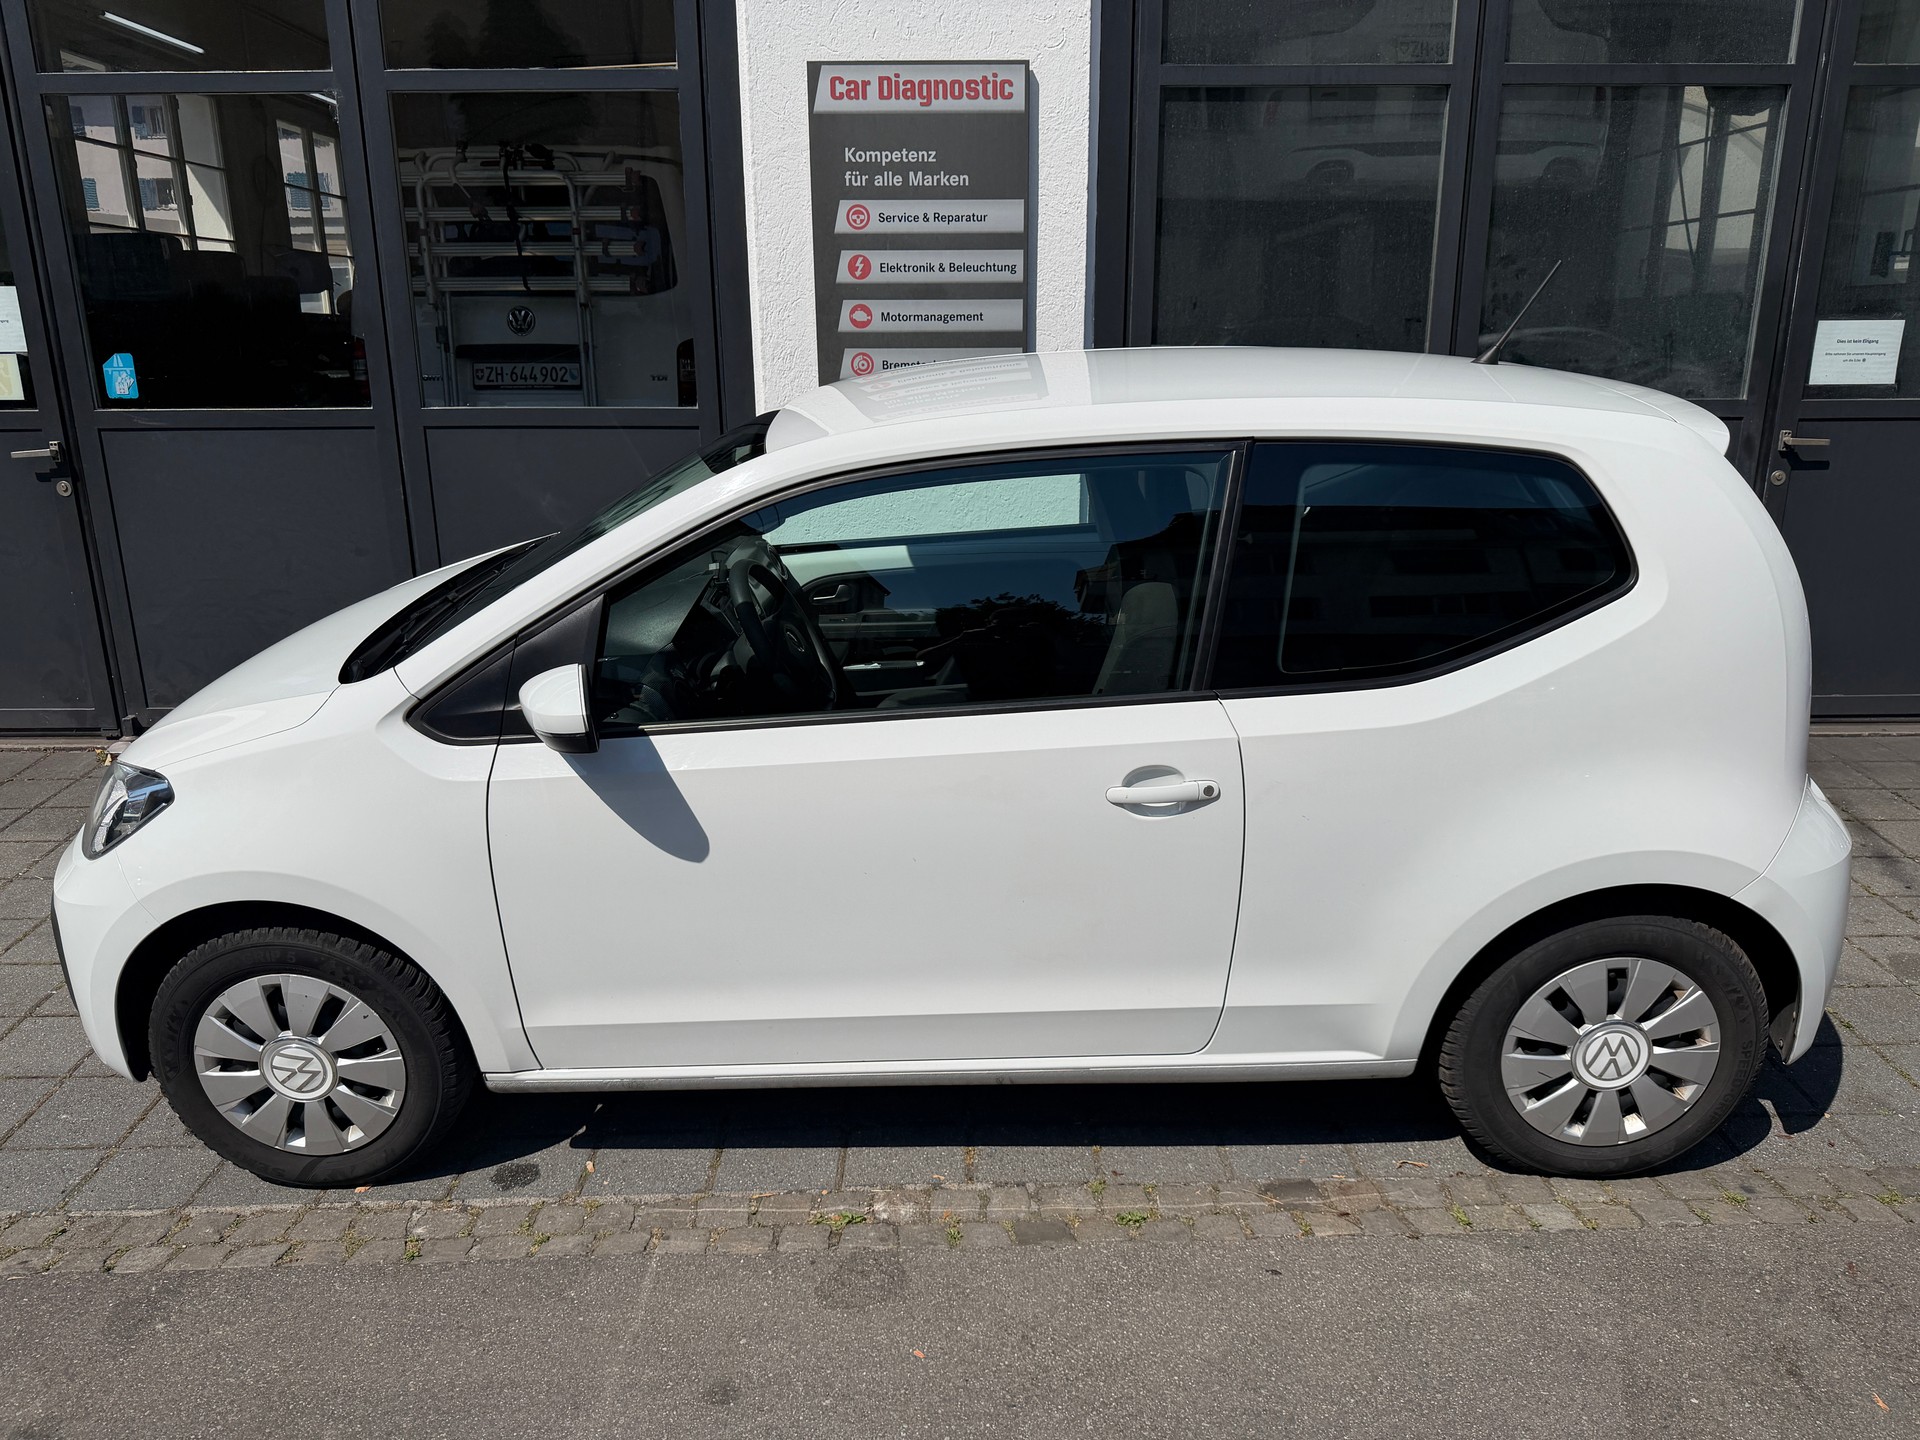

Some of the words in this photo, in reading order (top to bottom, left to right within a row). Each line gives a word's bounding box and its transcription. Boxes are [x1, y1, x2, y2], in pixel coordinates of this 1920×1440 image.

[829, 75, 871, 101] Car
[877, 72, 1014, 107] Diagnostic
[844, 147, 937, 166] Kompetenz
[844, 170, 869, 187] für
[874, 170, 903, 187] alle
[908, 170, 969, 187] Marken
[878, 212, 920, 223] Service
[922, 212, 930, 223] &
[933, 212, 988, 225] Reparatur
[879, 262, 936, 273] Elektronik
[938, 262, 946, 273] &
[948, 261, 1017, 275] Beleuchtung
[880, 311, 984, 325] Motormanagement
